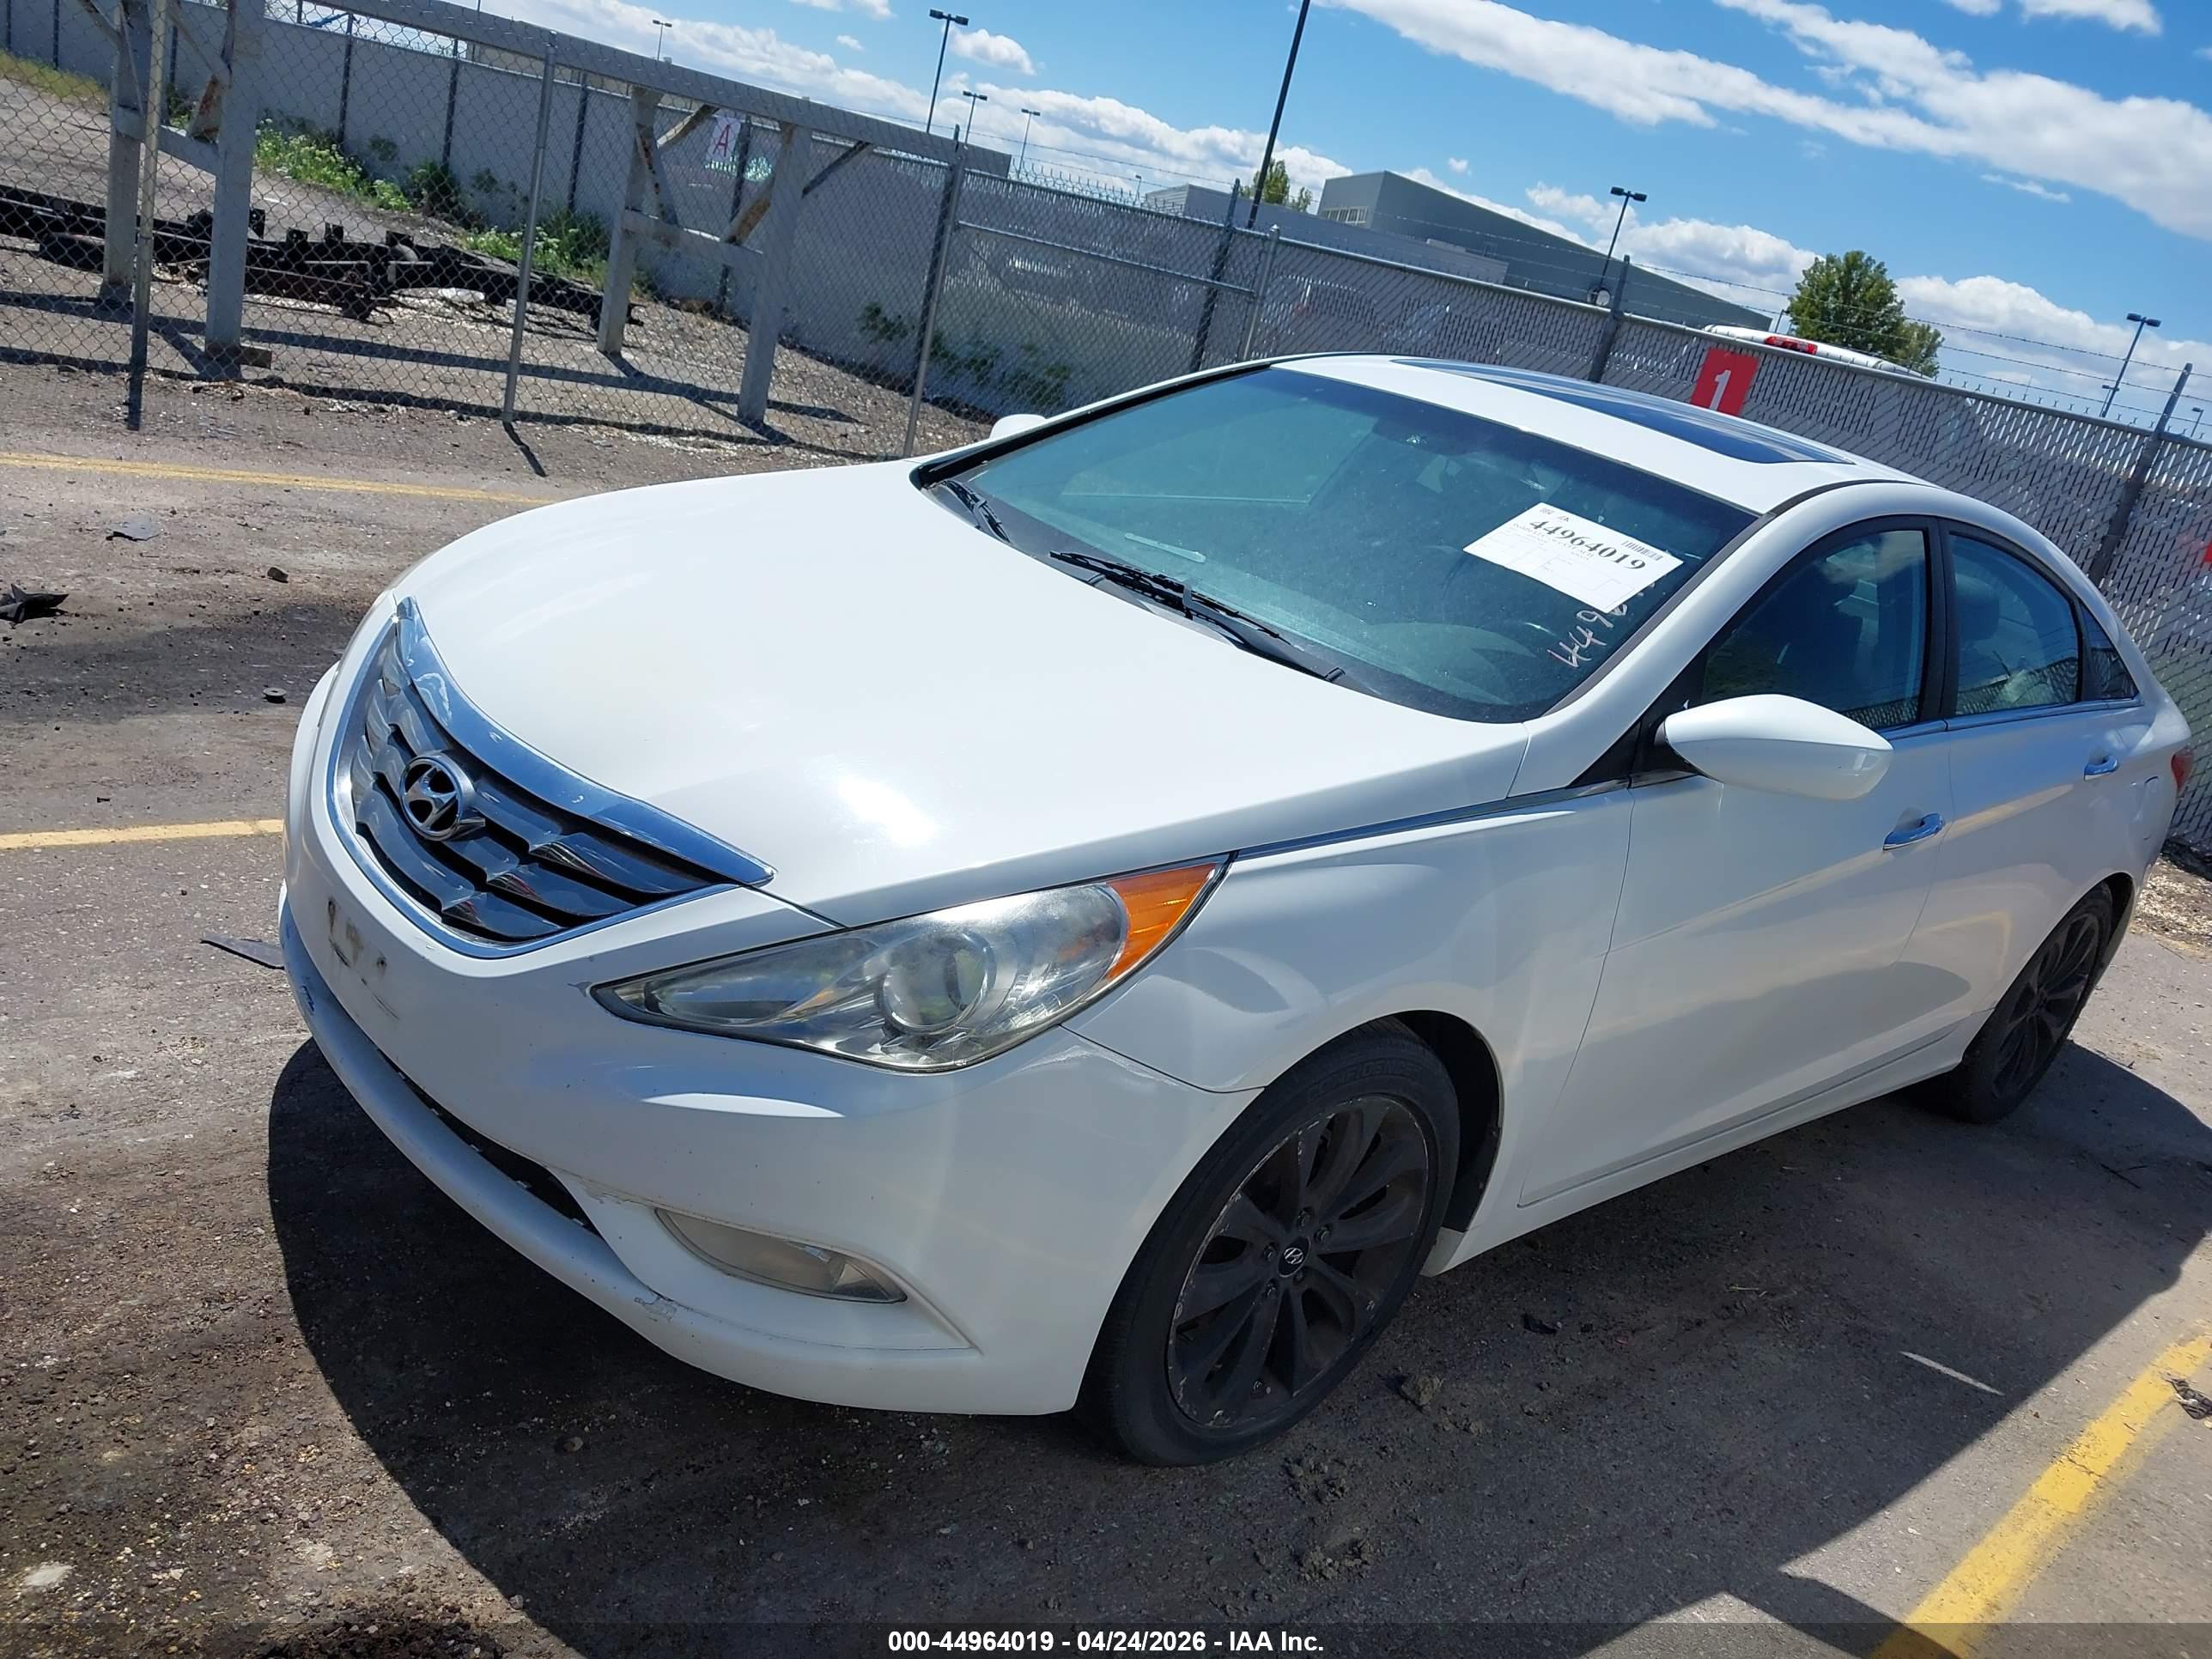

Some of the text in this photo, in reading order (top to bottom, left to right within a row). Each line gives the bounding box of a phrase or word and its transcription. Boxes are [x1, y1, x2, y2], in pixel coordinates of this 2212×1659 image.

[713, 124, 730, 157] A
[1709, 369, 1732, 411] 1
[1528, 520, 1647, 570] 44964019
